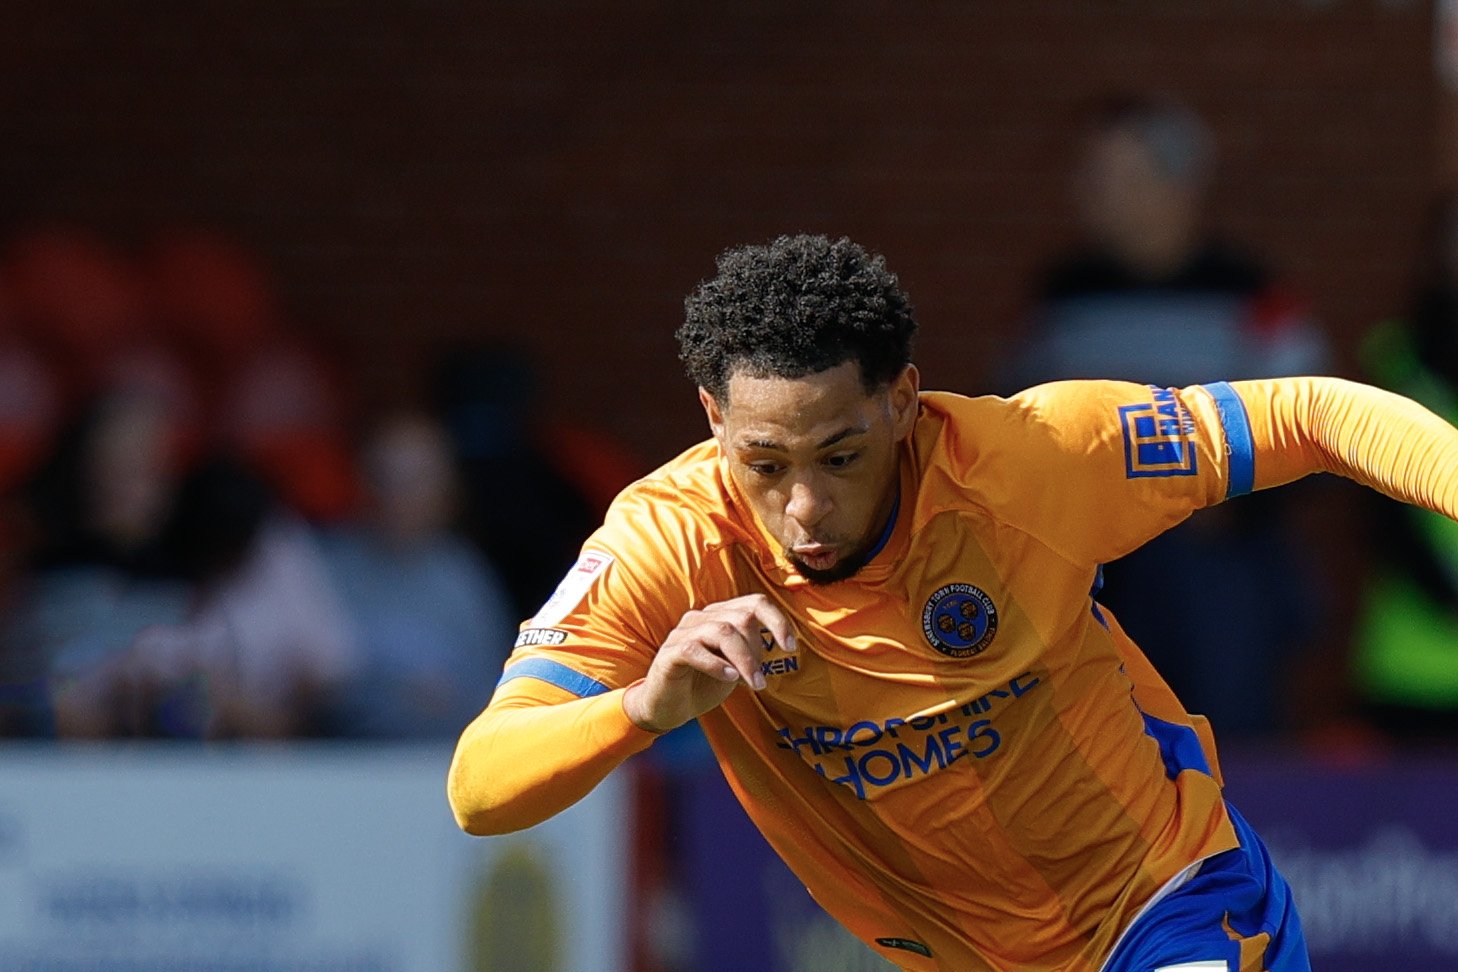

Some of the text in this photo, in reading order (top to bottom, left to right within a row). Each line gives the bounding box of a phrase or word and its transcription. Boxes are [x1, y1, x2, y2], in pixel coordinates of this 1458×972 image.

[932, 587, 950, 602] TOWN
[950, 585, 982, 600] FOOTBALL
[982, 597, 995, 614] CLUB
[760, 656, 798, 676] XEN
[814, 720, 1001, 800] HOMES
